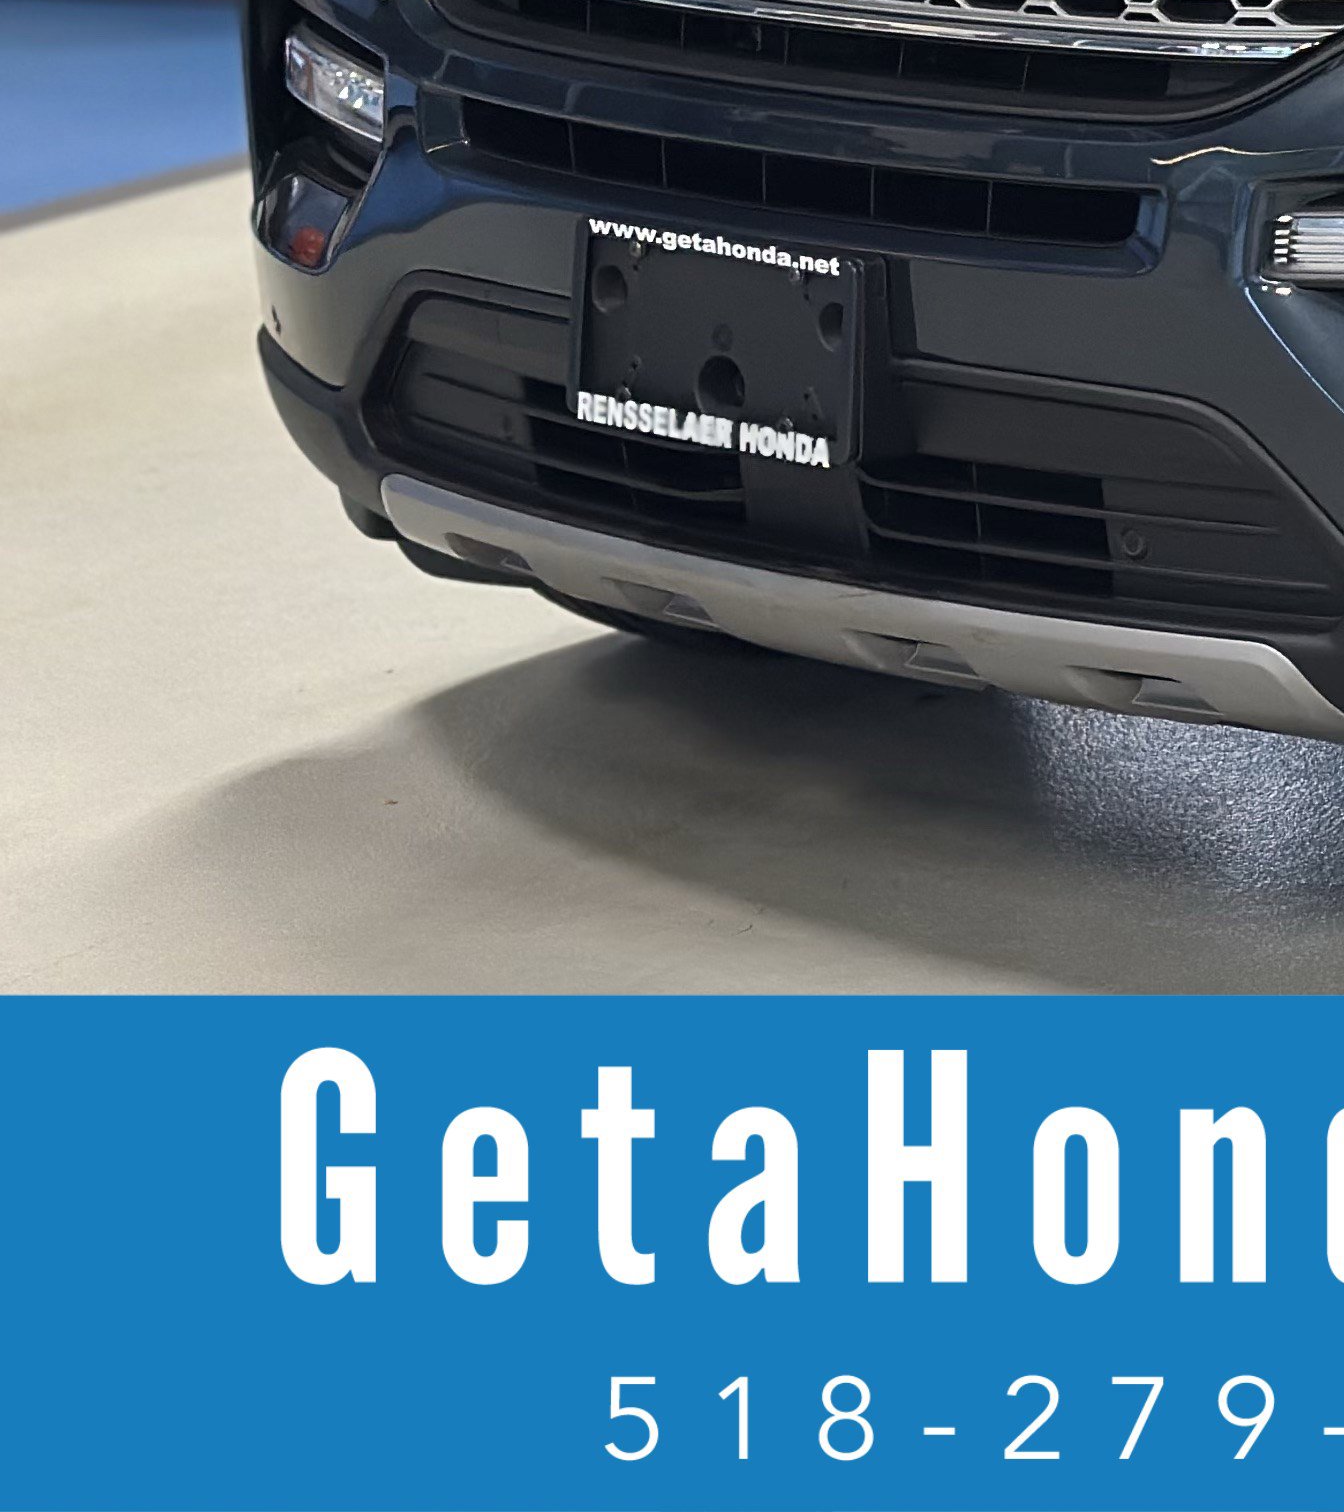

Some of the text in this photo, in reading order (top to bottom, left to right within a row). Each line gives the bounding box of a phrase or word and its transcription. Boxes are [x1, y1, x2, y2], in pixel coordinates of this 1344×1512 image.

[588, 218, 840, 277] www.getahonda.net
[577, 391, 831, 468] RENSSELAER HONDA
